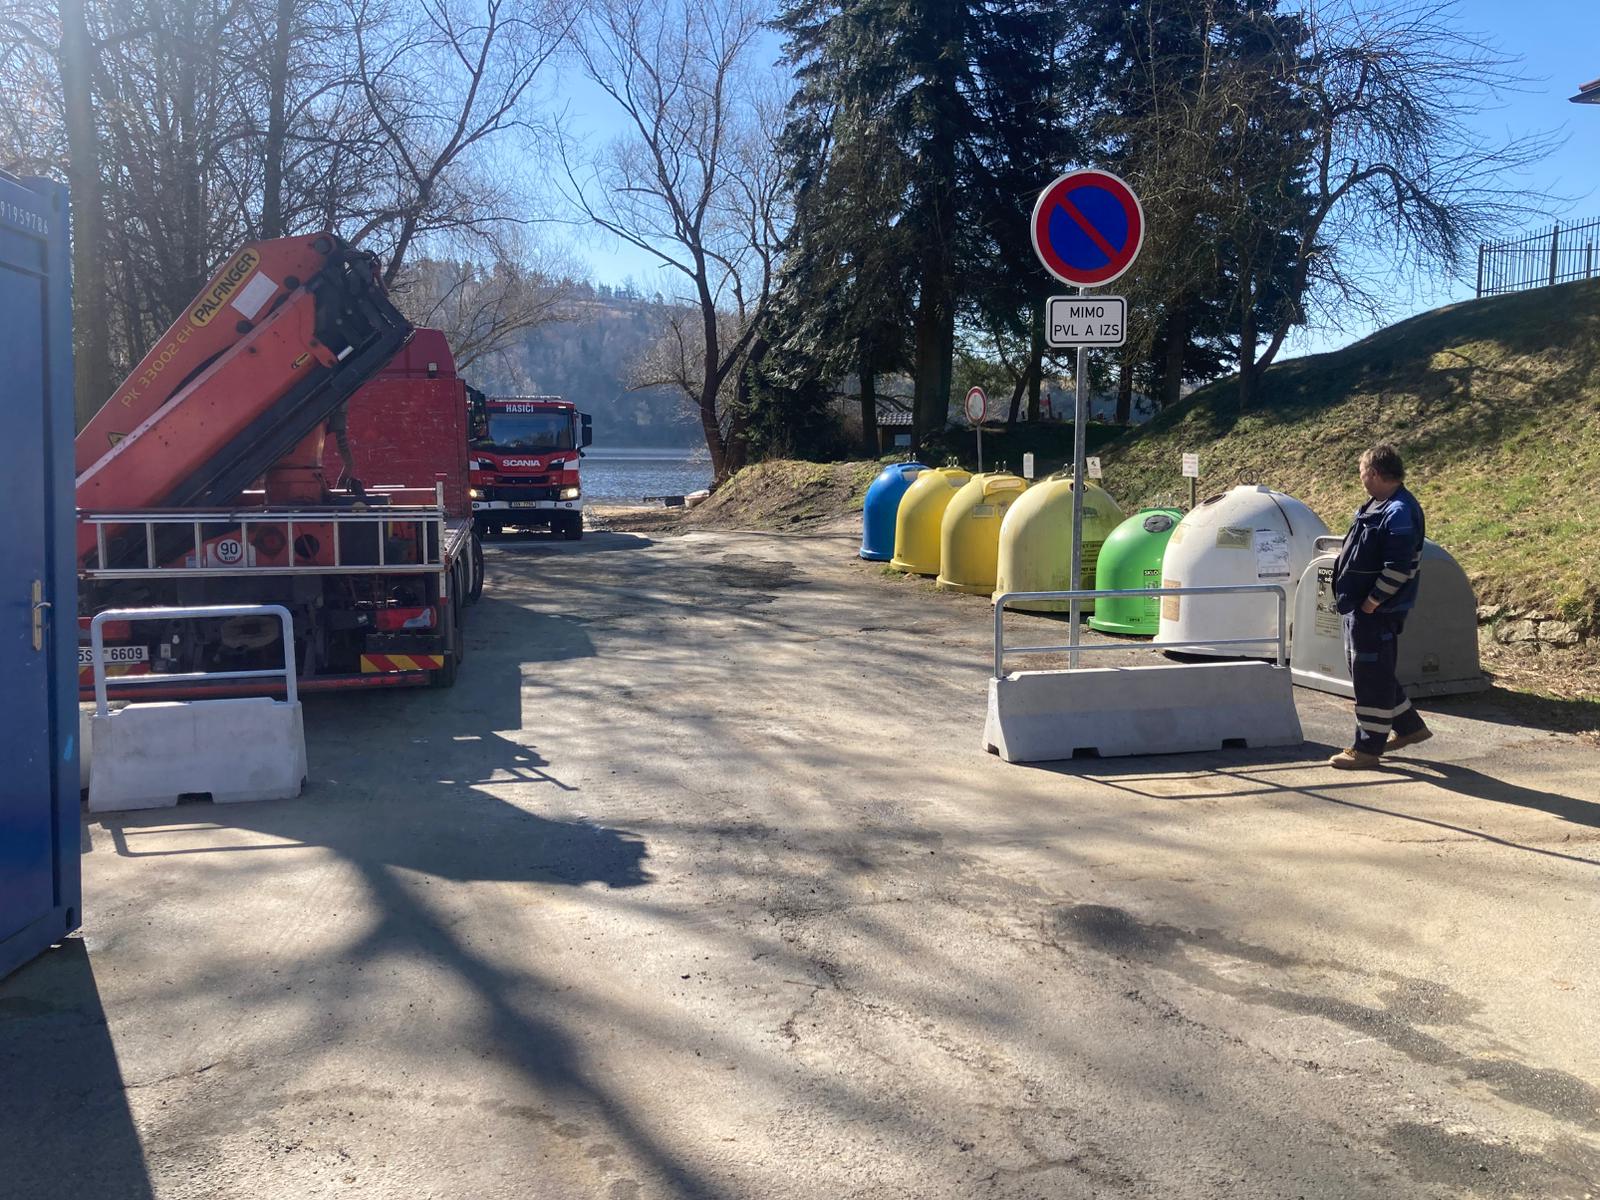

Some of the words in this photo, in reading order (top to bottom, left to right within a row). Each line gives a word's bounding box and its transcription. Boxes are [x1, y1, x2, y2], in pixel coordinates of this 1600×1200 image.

[194, 252, 258, 323] PALFINGER
[1070, 306, 1105, 318] MIMO
[1054, 324, 1079, 336] PVL
[1085, 324, 1094, 336] A
[1100, 324, 1120, 336] IZS
[121, 387, 142, 408] PK
[506, 403, 534, 413] HASIČI
[503, 459, 541, 467] SCANIA
[220, 542, 238, 555] 90
[111, 647, 143, 661] 6609
